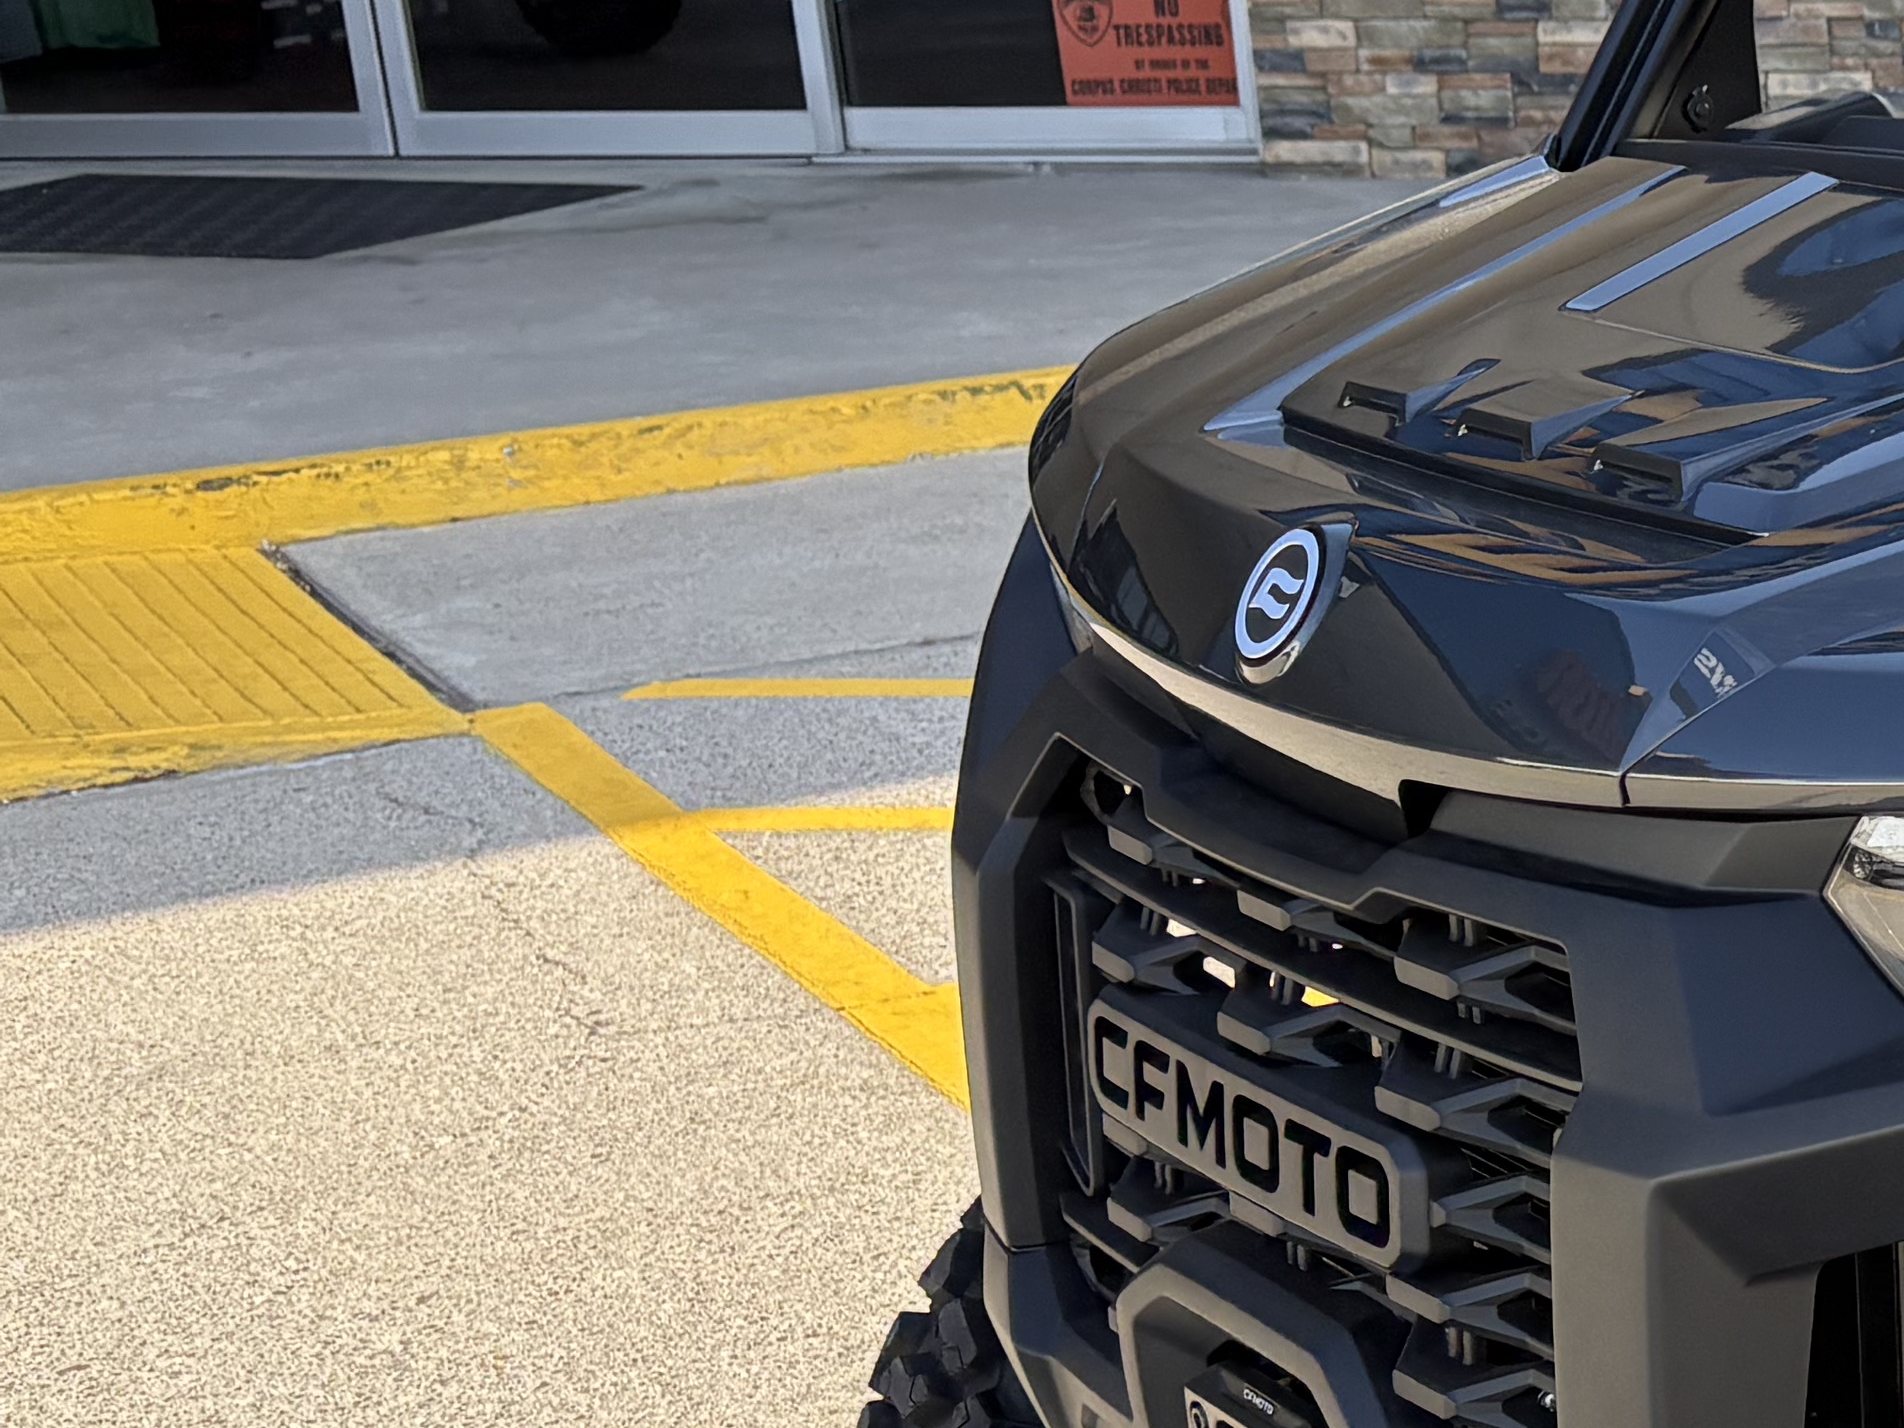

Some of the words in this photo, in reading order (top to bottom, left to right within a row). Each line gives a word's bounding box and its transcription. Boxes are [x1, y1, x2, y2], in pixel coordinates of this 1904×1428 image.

[1113, 22, 1225, 48] TRESPASSING
[1093, 1015, 1392, 1251] CFMOTO
[1243, 1388, 1275, 1415] CFMOTO
